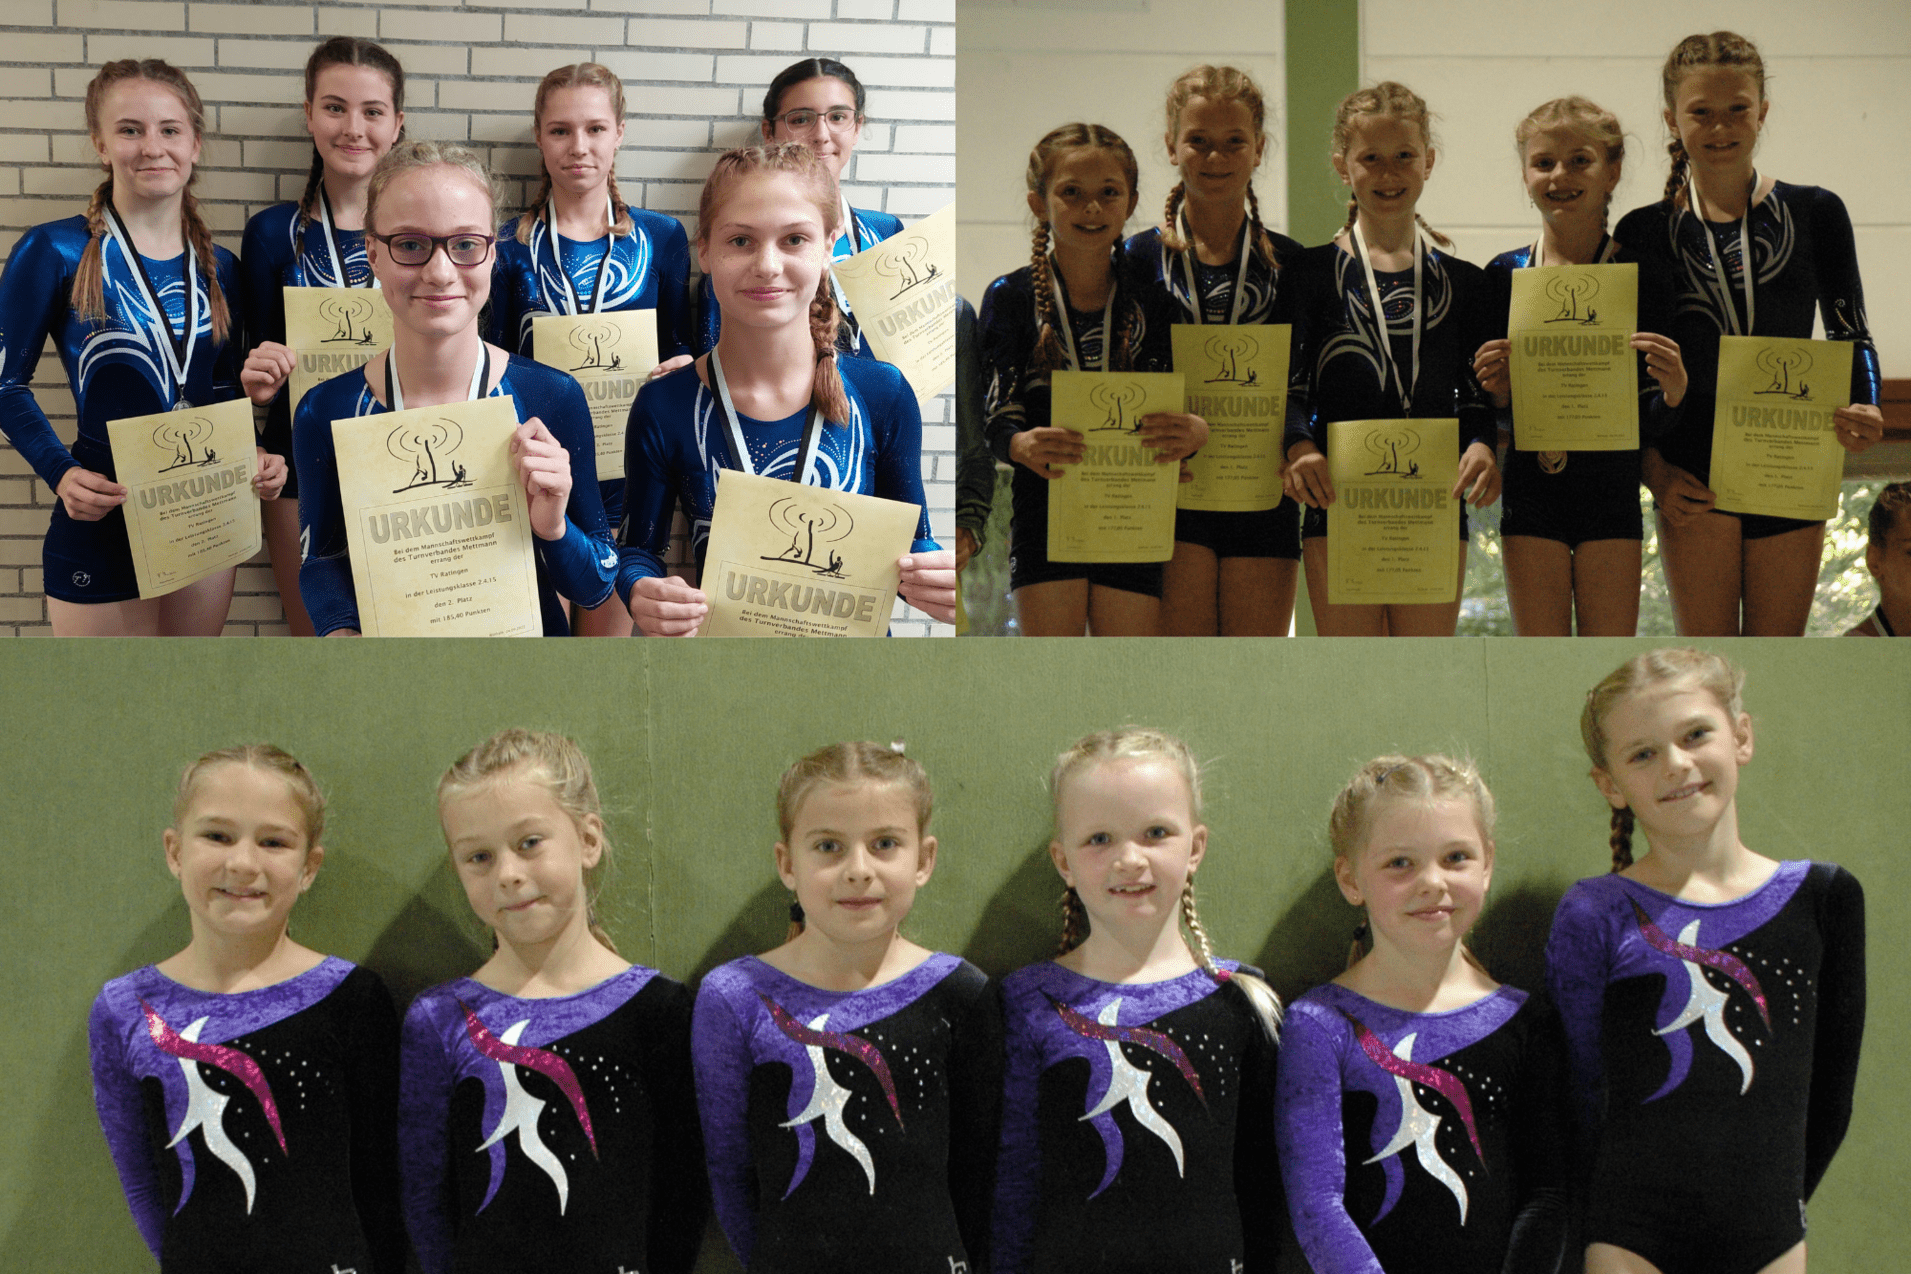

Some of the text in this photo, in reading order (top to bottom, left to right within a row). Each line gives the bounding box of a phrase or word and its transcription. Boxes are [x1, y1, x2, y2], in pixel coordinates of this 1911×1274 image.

[877, 280, 955, 337] URKUND
[1524, 334, 1624, 357] URKUNDE
[303, 354, 375, 373] URKU
[580, 378, 647, 401] KUND
[1188, 395, 1280, 418] URKUNDE
[1731, 405, 1835, 432] URKUNDE
[1077, 444, 1168, 467] RKUND
[140, 464, 247, 509] URKUNDE
[1344, 488, 1447, 509] URKUNDE
[369, 494, 512, 544] URKUNDE
[393, 540, 497, 563] des Turnverbandes Mettmann
[405, 545, 420, 553] dem
[421, 532, 495, 552] Mannschaftswettkampf
[430, 553, 464, 566] errang der
[440, 567, 469, 579] Ratingen
[413, 589, 425, 597] der
[426, 580, 477, 596] Leistungsklasse
[478, 577, 497, 585] 2.4.15
[725, 571, 876, 622] URKUNDE
[434, 600, 447, 608] den
[457, 596, 473, 604] Platz
[430, 607, 491, 624] mit 185,40 Punkten
[770, 614, 848, 631] Mannschaftswettkampf
[754, 619, 808, 633] Turnverbandes
[810, 629, 847, 637] Mettmann
[774, 629, 796, 637] errang
